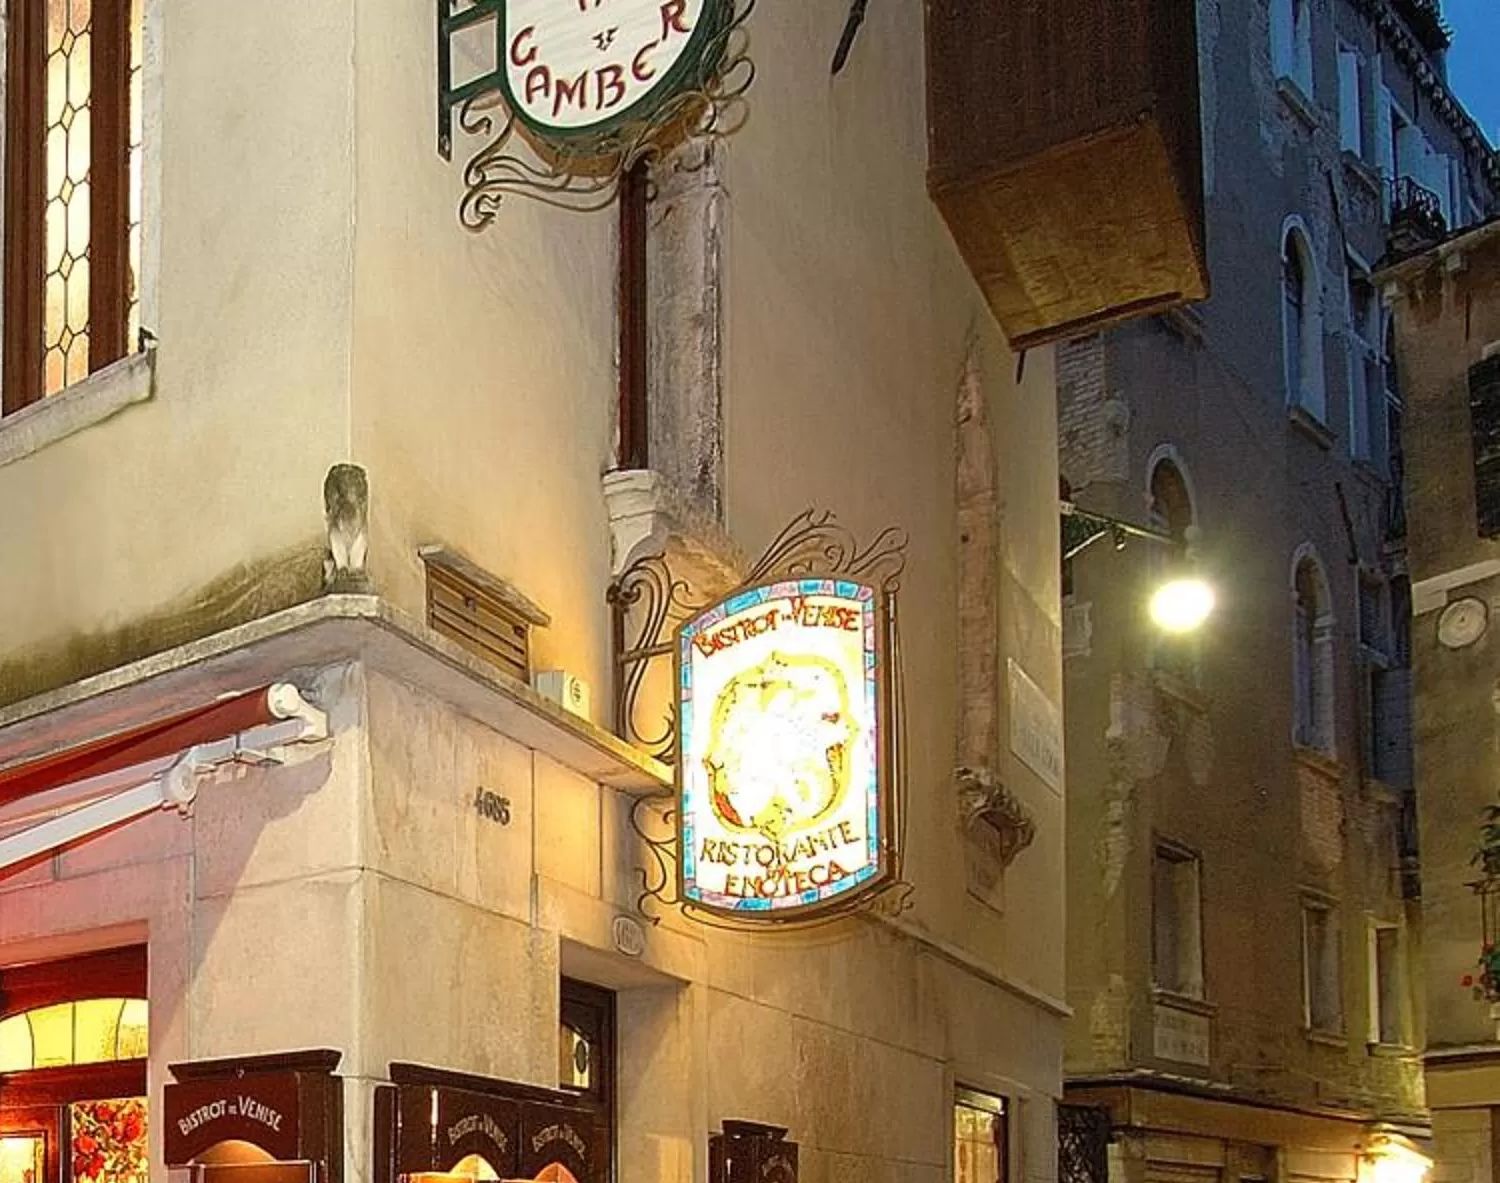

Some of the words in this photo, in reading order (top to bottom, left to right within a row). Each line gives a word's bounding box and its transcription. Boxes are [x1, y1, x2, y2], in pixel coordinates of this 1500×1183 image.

[692, 609, 780, 658] BISTROT
[790, 596, 860, 632] VENISE
[699, 820, 860, 867] RISTORANTE
[723, 860, 850, 898] ENOTECA
[177, 1100, 227, 1136] BISTROT
[238, 1096, 284, 1132] VENISE
